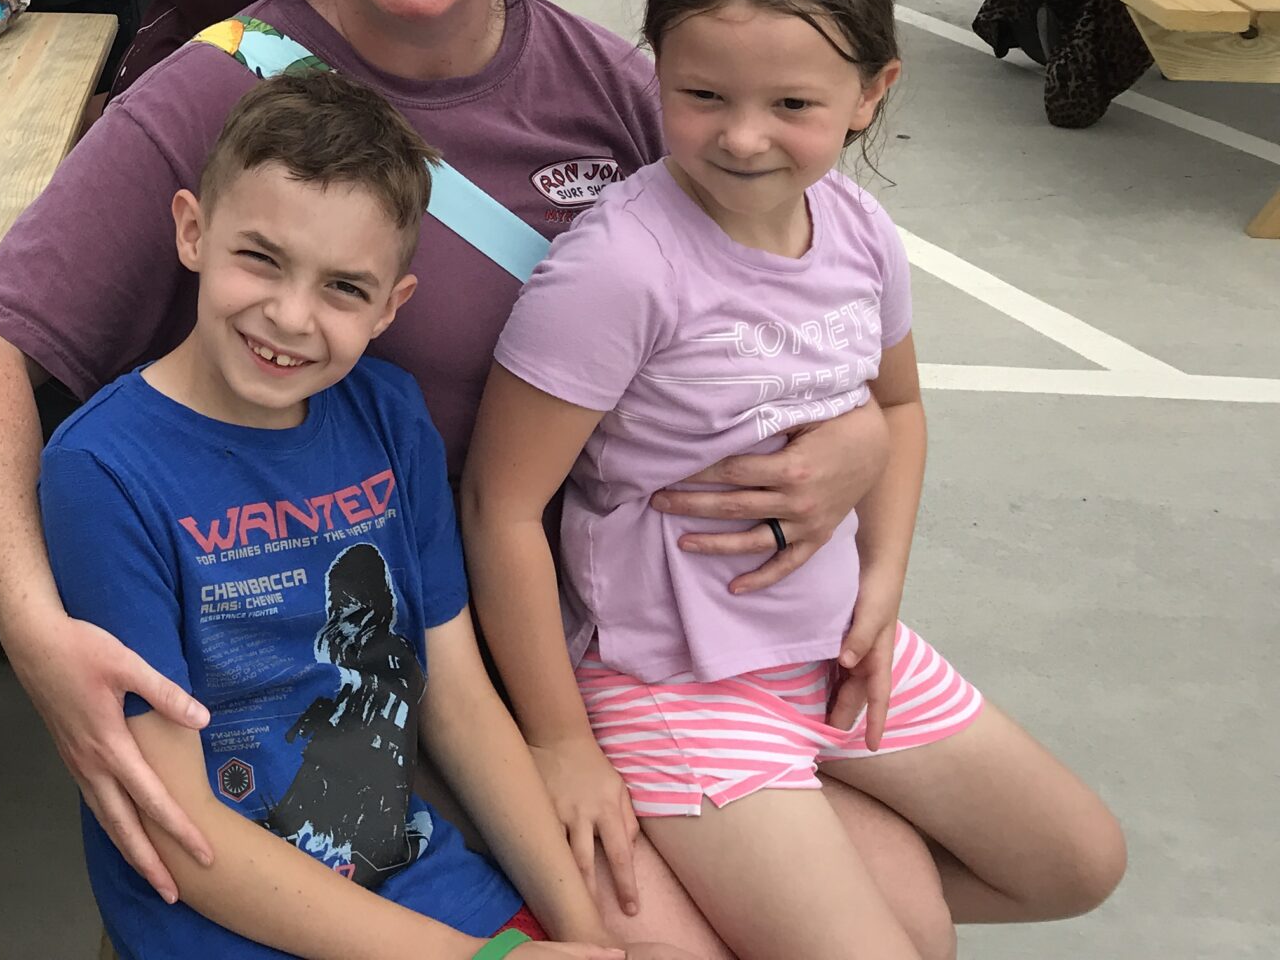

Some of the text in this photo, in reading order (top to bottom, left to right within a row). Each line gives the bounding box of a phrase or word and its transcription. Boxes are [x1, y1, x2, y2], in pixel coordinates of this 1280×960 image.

[540, 163, 579, 194] RON
[556, 183, 608, 200] SURF SH
[177, 468, 396, 554] WANTED
[196, 554, 217, 566] FOR
[220, 544, 261, 563] CRIMES
[264, 535, 319, 554] AGAINST
[323, 528, 346, 543] THE
[200, 568, 308, 602] CHEWBACCA
[199, 606, 279, 624] RESISTANCE FIGHTER
[200, 592, 284, 615] ALIAS: CHEWIE
